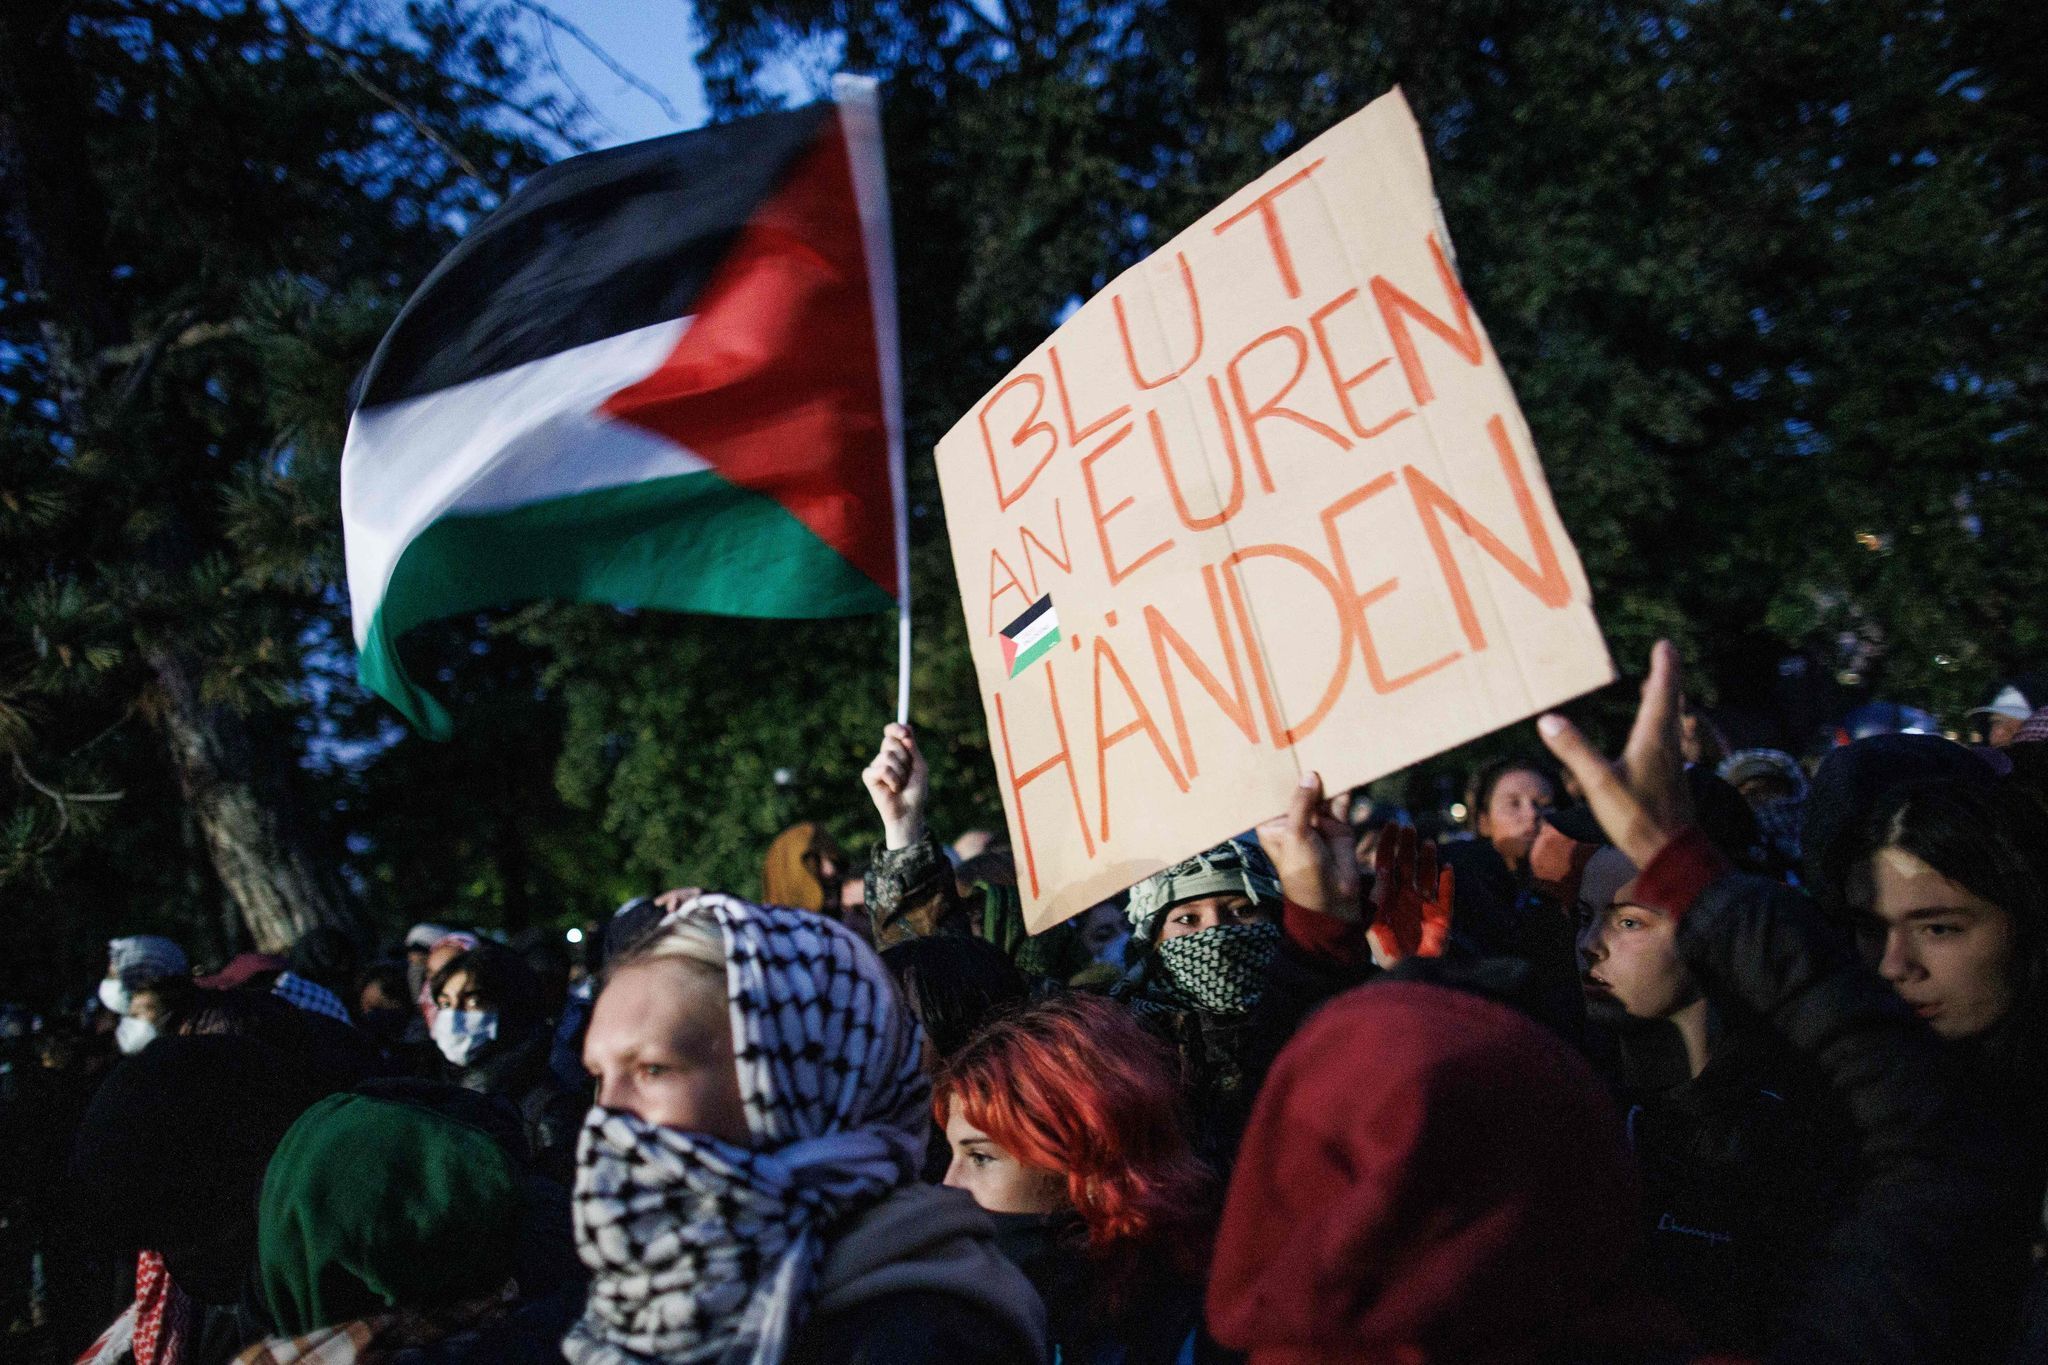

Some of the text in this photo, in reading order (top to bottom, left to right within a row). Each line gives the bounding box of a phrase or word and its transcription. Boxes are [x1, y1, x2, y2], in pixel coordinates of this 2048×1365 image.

[978, 158, 1325, 512] BLUT
[989, 231, 1484, 636] AN EUREN
[994, 414, 1572, 900] HÄNDEN
